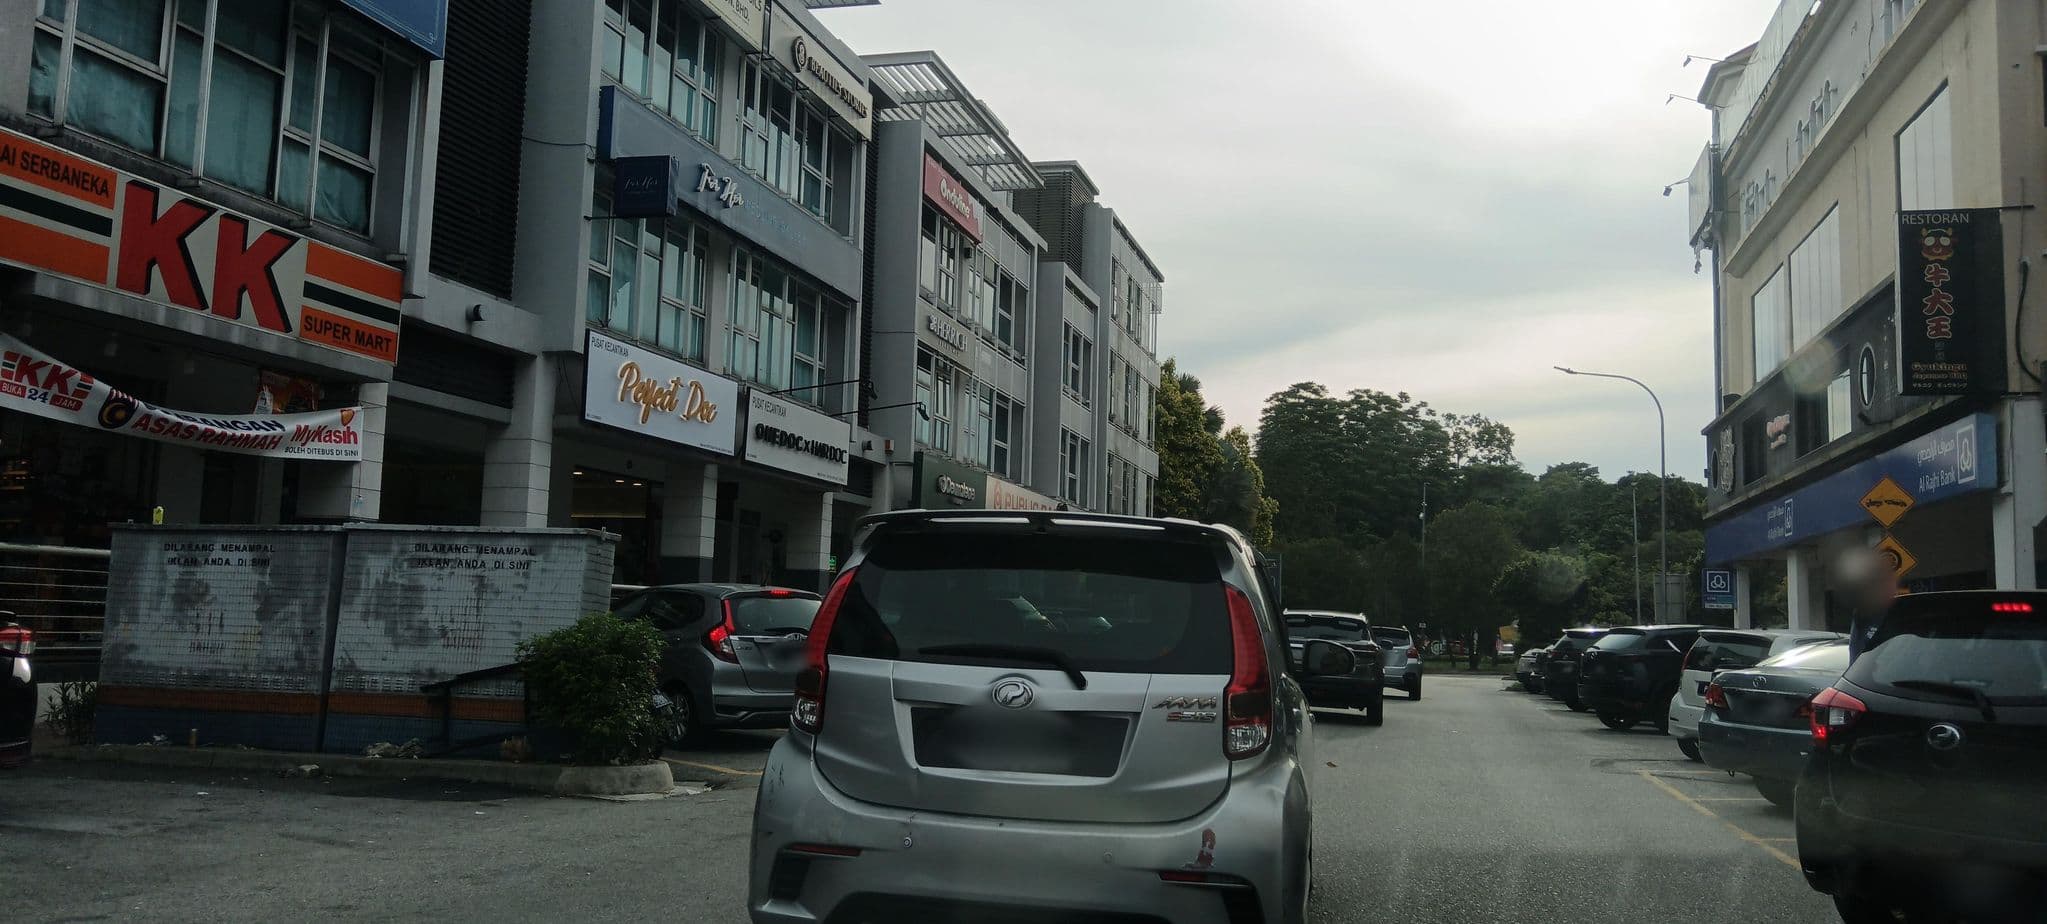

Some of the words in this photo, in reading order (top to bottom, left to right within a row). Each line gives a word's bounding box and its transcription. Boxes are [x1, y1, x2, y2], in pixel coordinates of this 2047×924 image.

[20, 151, 109, 198] SERBANEKA
[1902, 212, 1969, 225] RESTORAN
[116, 179, 301, 333] KK
[1922, 262, 1955, 340] 牛大王
[303, 314, 352, 342] SUPER
[354, 329, 392, 353] MART
[14, 354, 78, 396] KK
[1, 381, 24, 397] BUKA
[26, 388, 49, 404] 24
[54, 395, 78, 410] JAM
[618, 361, 685, 425] Perfect
[132, 413, 199, 441] ASAS
[196, 427, 283, 450] RAHMAH
[290, 424, 359, 447] MyKasih
[306, 447, 335, 456] DITEBUS
[335, 448, 343, 457] DI
[343, 449, 359, 457] SINI
[164, 543, 215, 553] DILARANG
[221, 543, 276, 553] MENAMPAL
[167, 557, 197, 567] IKLAN
[203, 557, 232, 567] ANDA
[237, 558, 247, 567] DI
[251, 558, 271, 567] SINI
[415, 543, 469, 554] DILARANG
[475, 545, 537, 556] MENAMPAL
[417, 558, 450, 569] IKLAN
[457, 559, 487, 569] ANDA
[494, 560, 504, 570] DI
[508, 560, 531, 570] SINI
